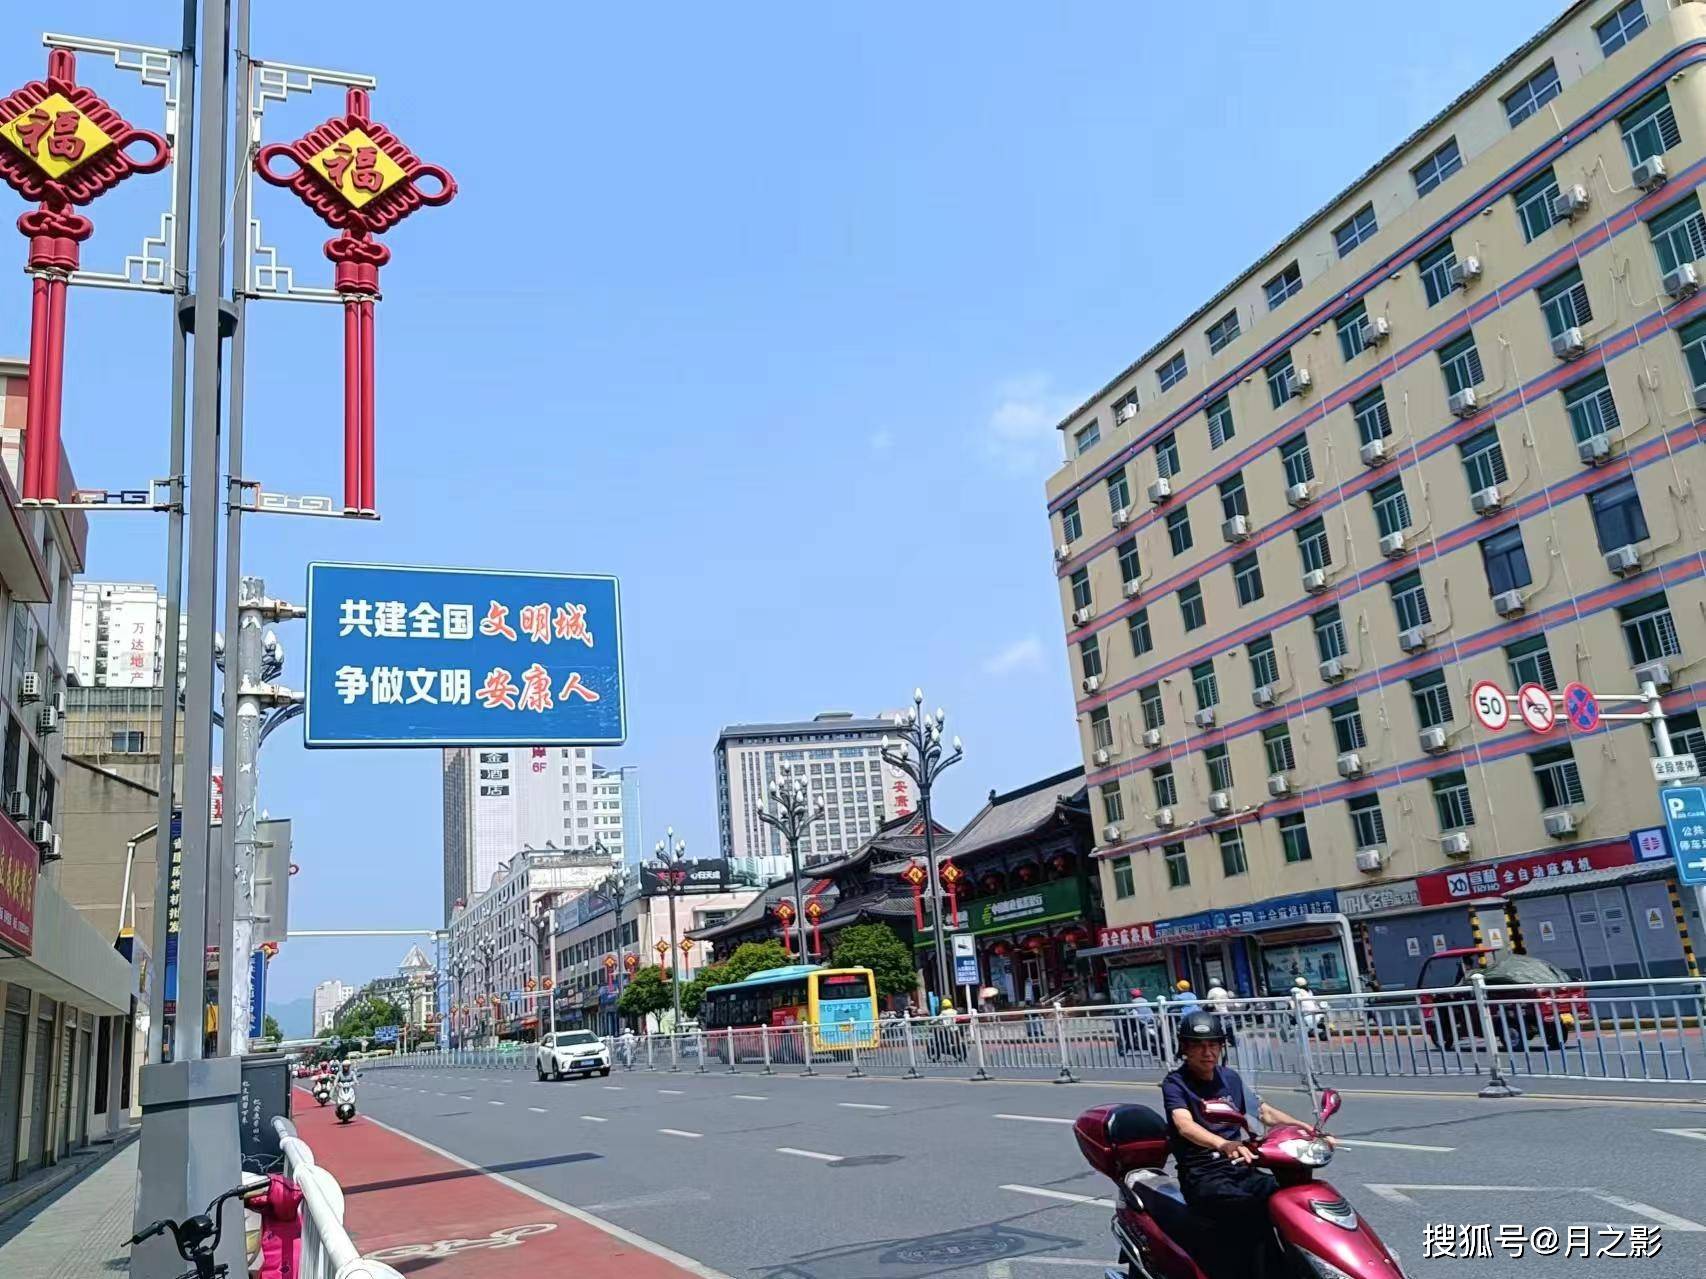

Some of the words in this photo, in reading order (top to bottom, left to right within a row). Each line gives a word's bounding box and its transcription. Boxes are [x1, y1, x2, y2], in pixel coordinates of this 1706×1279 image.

[16, 108, 85, 162] 福
[323, 143, 384, 193] 福
[338, 598, 594, 648] 共建全国文明城
[129, 622, 146, 684] 万达地产
[334, 663, 600, 713] 争做文明安康人
[1479, 696, 1502, 716] 50
[532, 762, 547, 773] 6F
